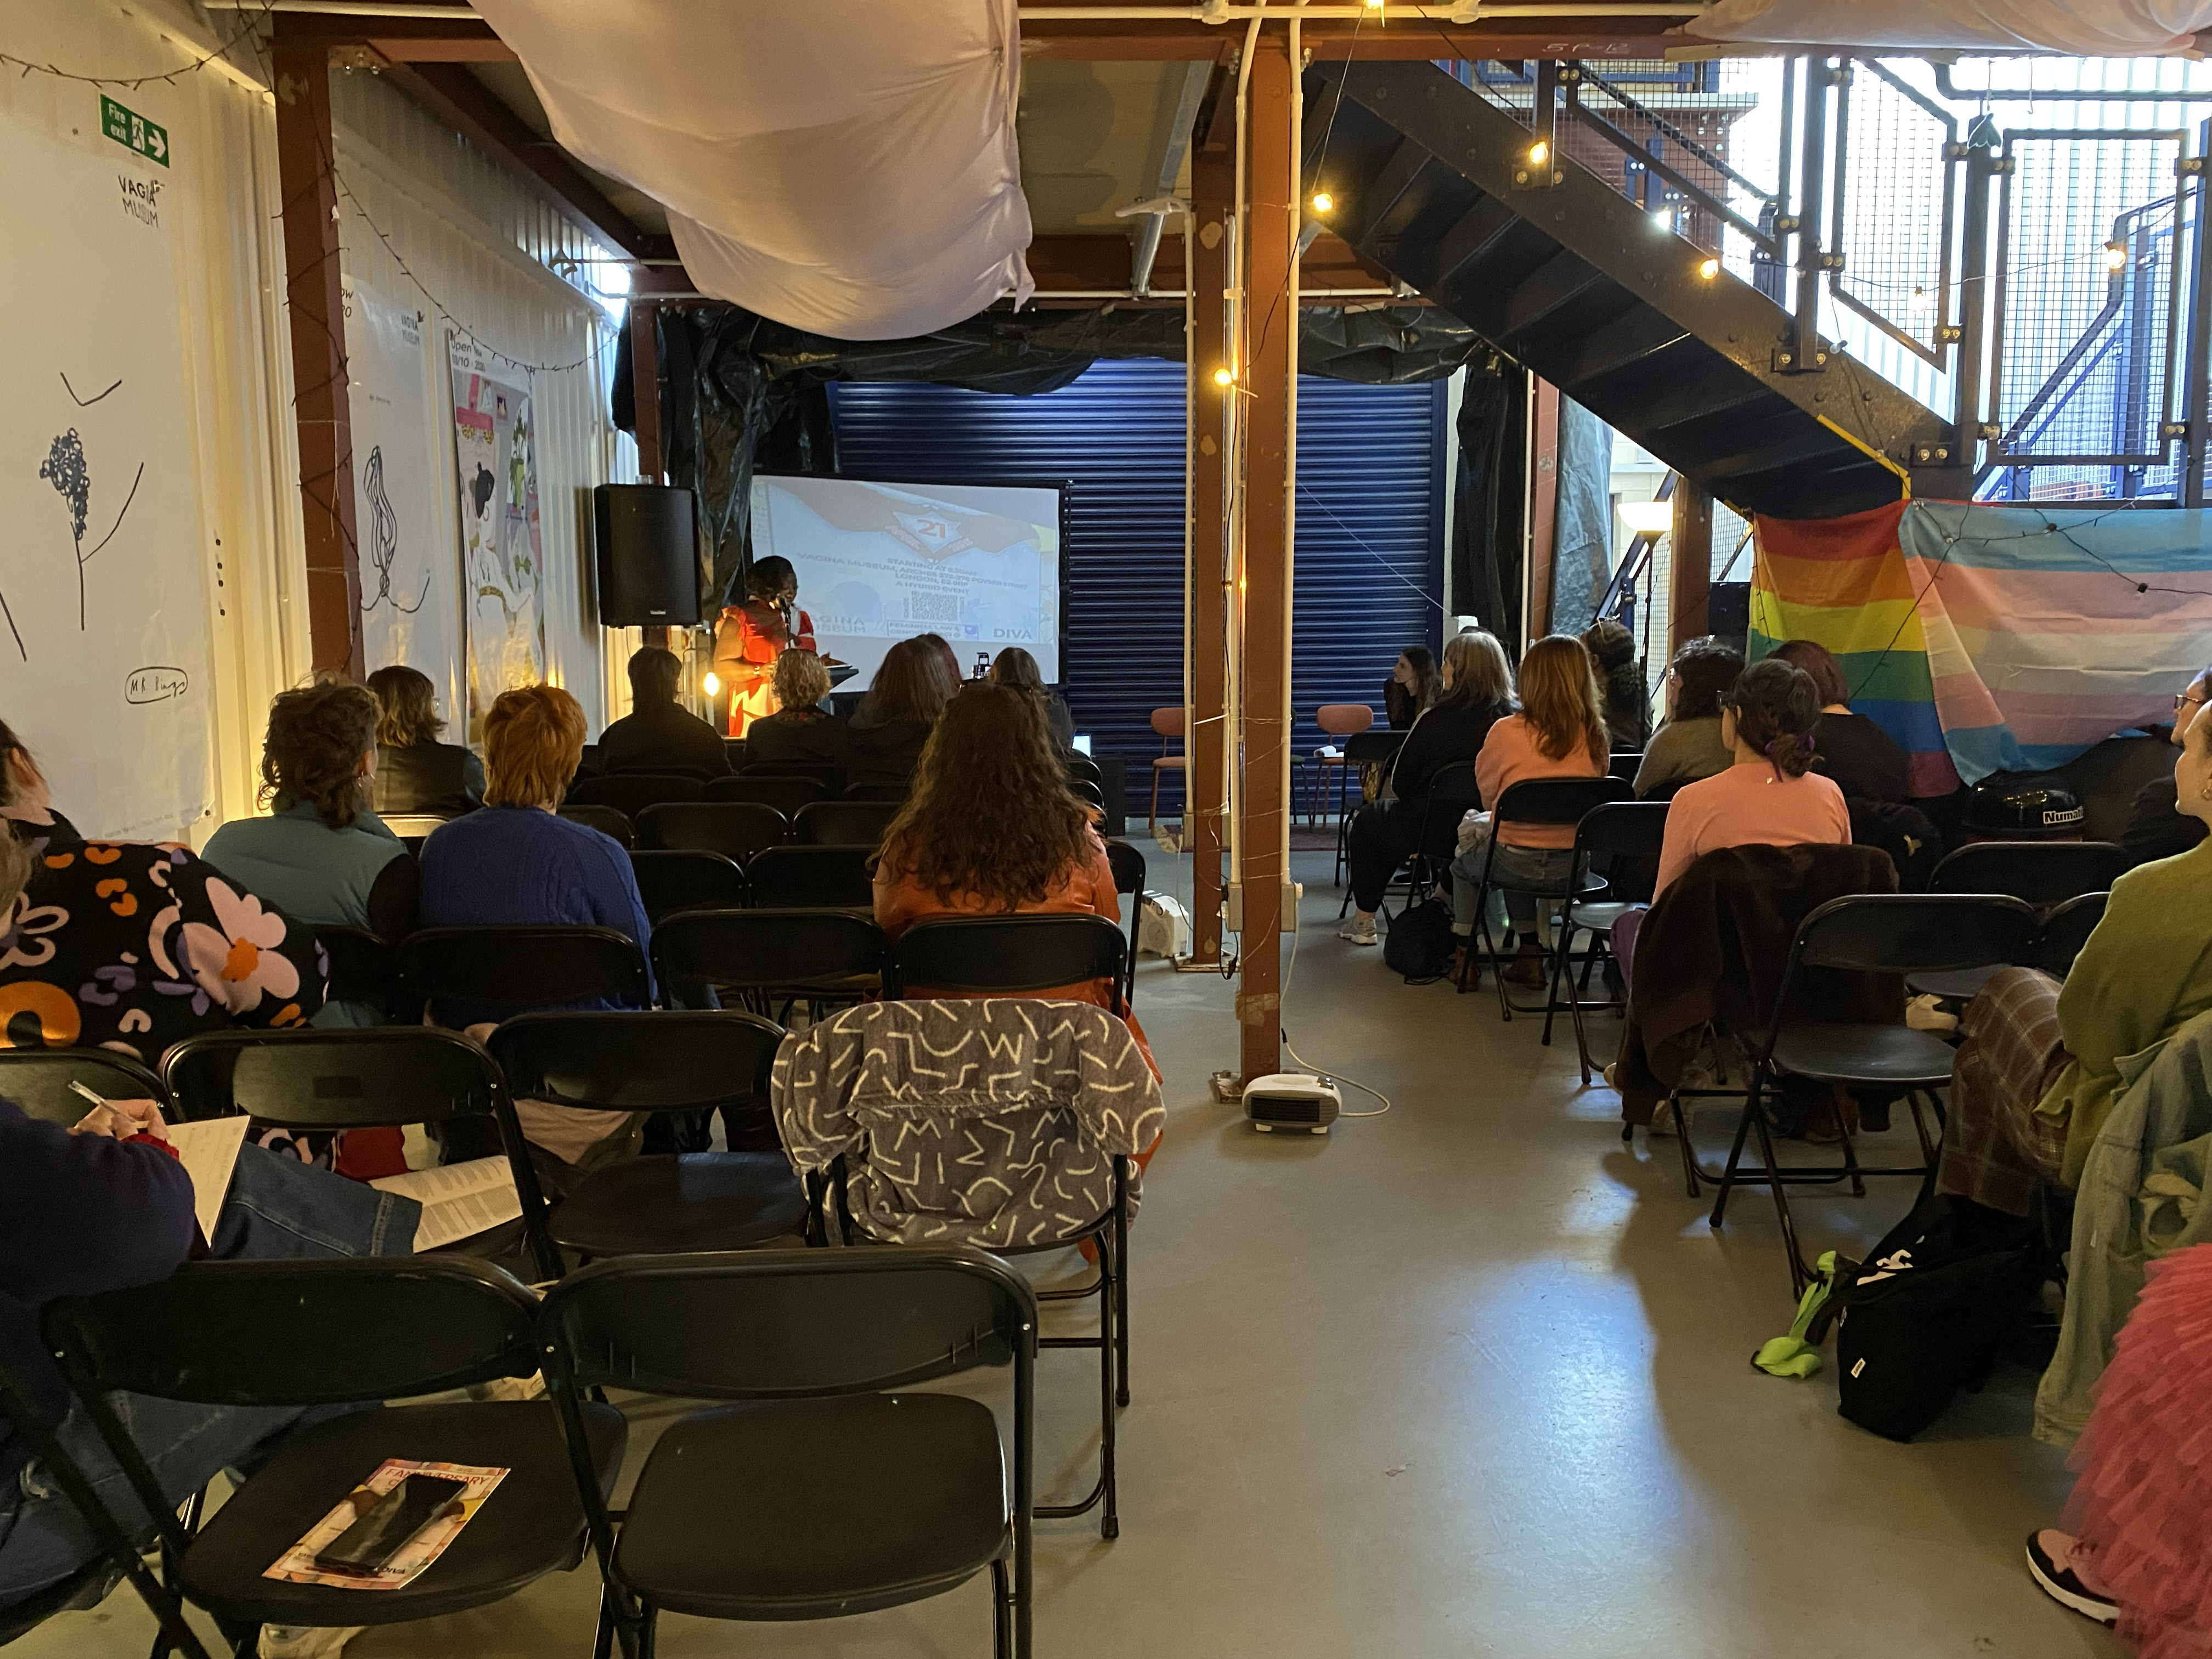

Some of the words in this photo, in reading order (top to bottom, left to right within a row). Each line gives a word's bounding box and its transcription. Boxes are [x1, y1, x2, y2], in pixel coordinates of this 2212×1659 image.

[108, 103, 126, 123] Fire
[110, 125, 127, 141] exit
[916, 519, 946, 539] 21
[796, 552, 844, 565] VAGINA
[899, 567, 938, 577] ARCHES
[887, 557, 933, 570] STARTING
[895, 572, 939, 584] LONDON,
[905, 581, 941, 591] HYBRID
[993, 628, 1032, 640] DIVA
